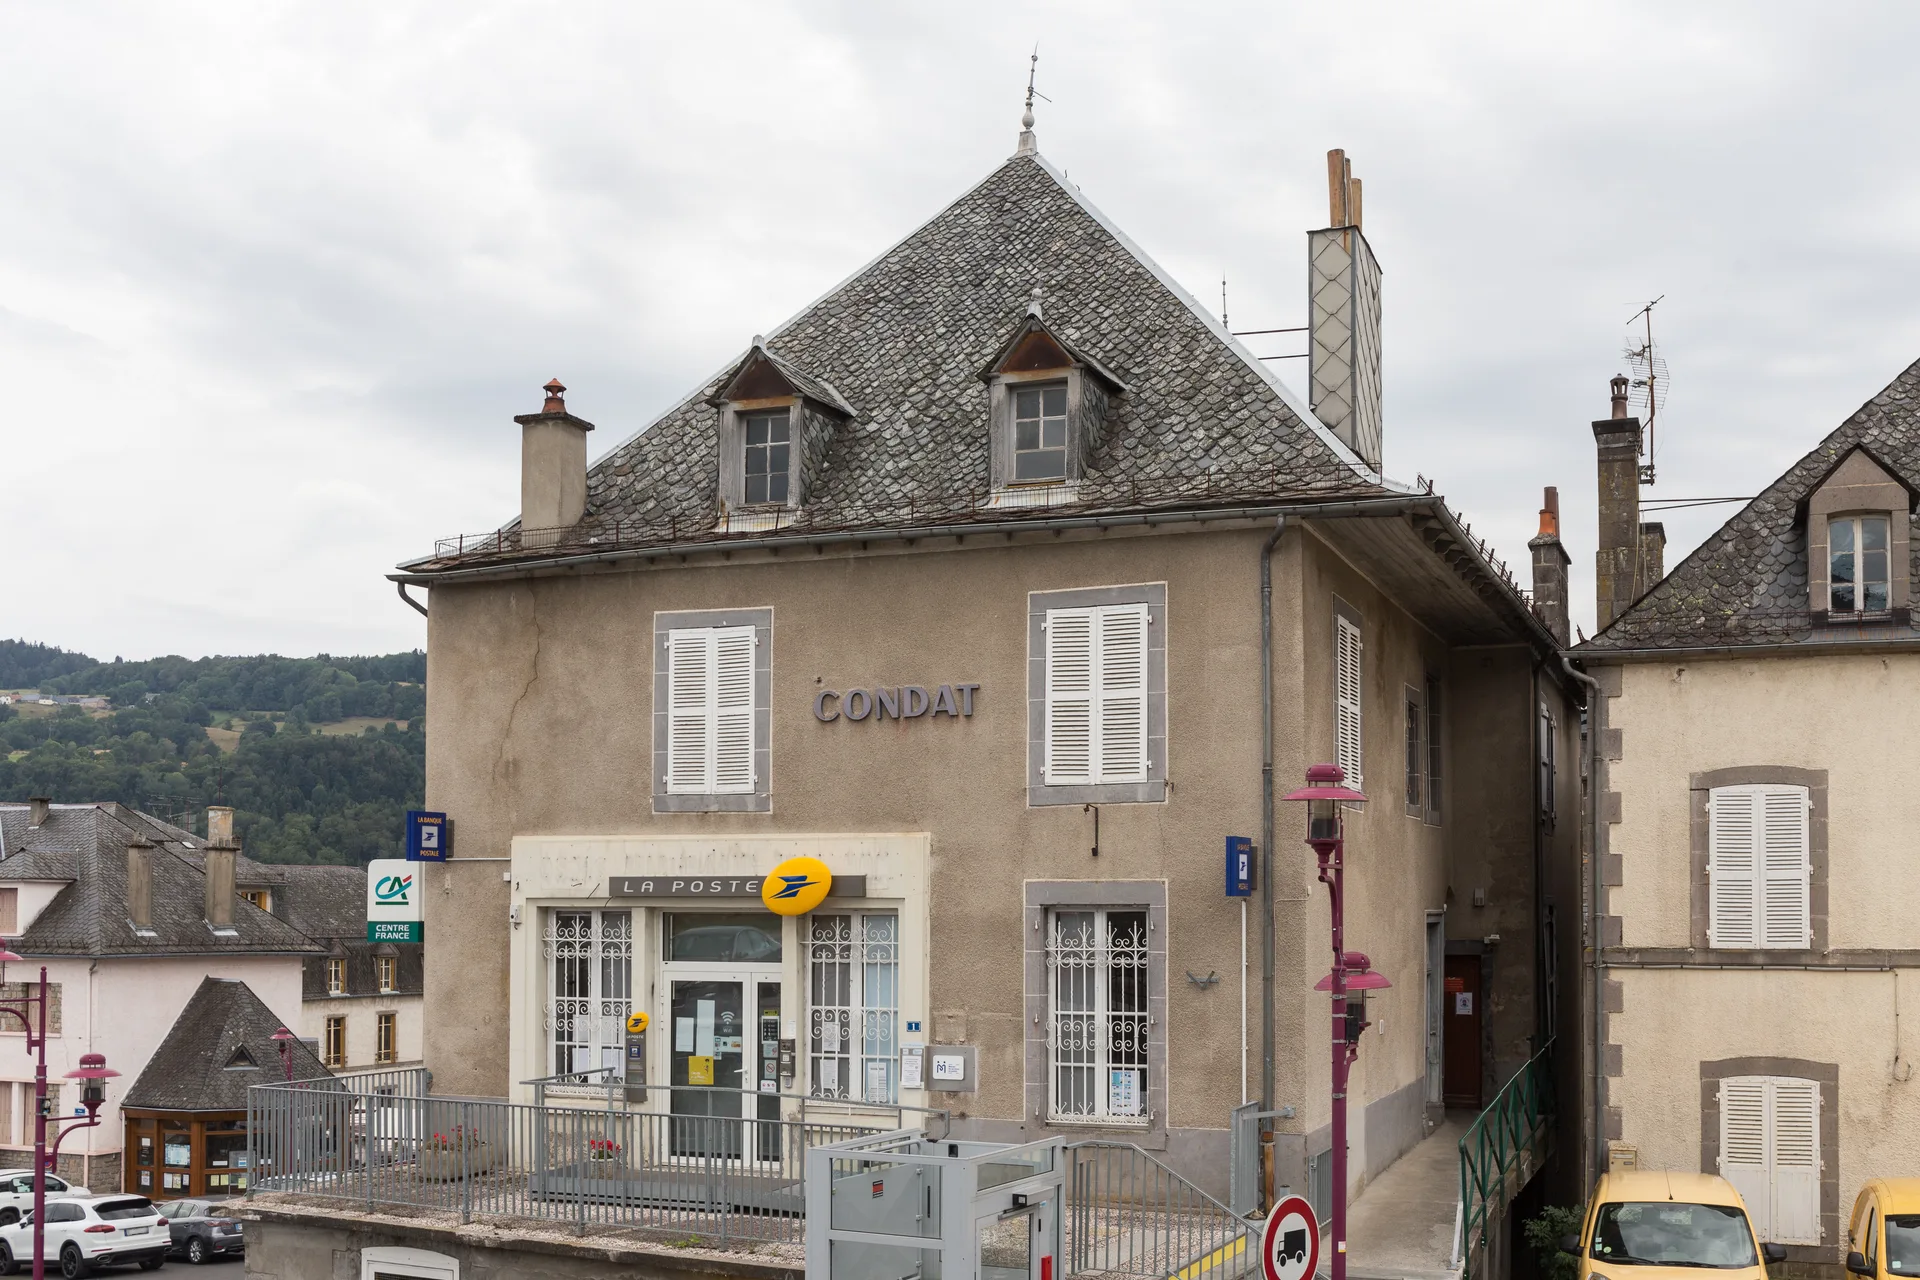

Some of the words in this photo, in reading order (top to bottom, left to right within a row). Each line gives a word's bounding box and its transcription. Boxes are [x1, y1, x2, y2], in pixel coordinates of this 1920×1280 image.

[813, 684, 980, 722] CONDAT
[623, 881, 654, 893] LA
[672, 881, 759, 893] POSTE
